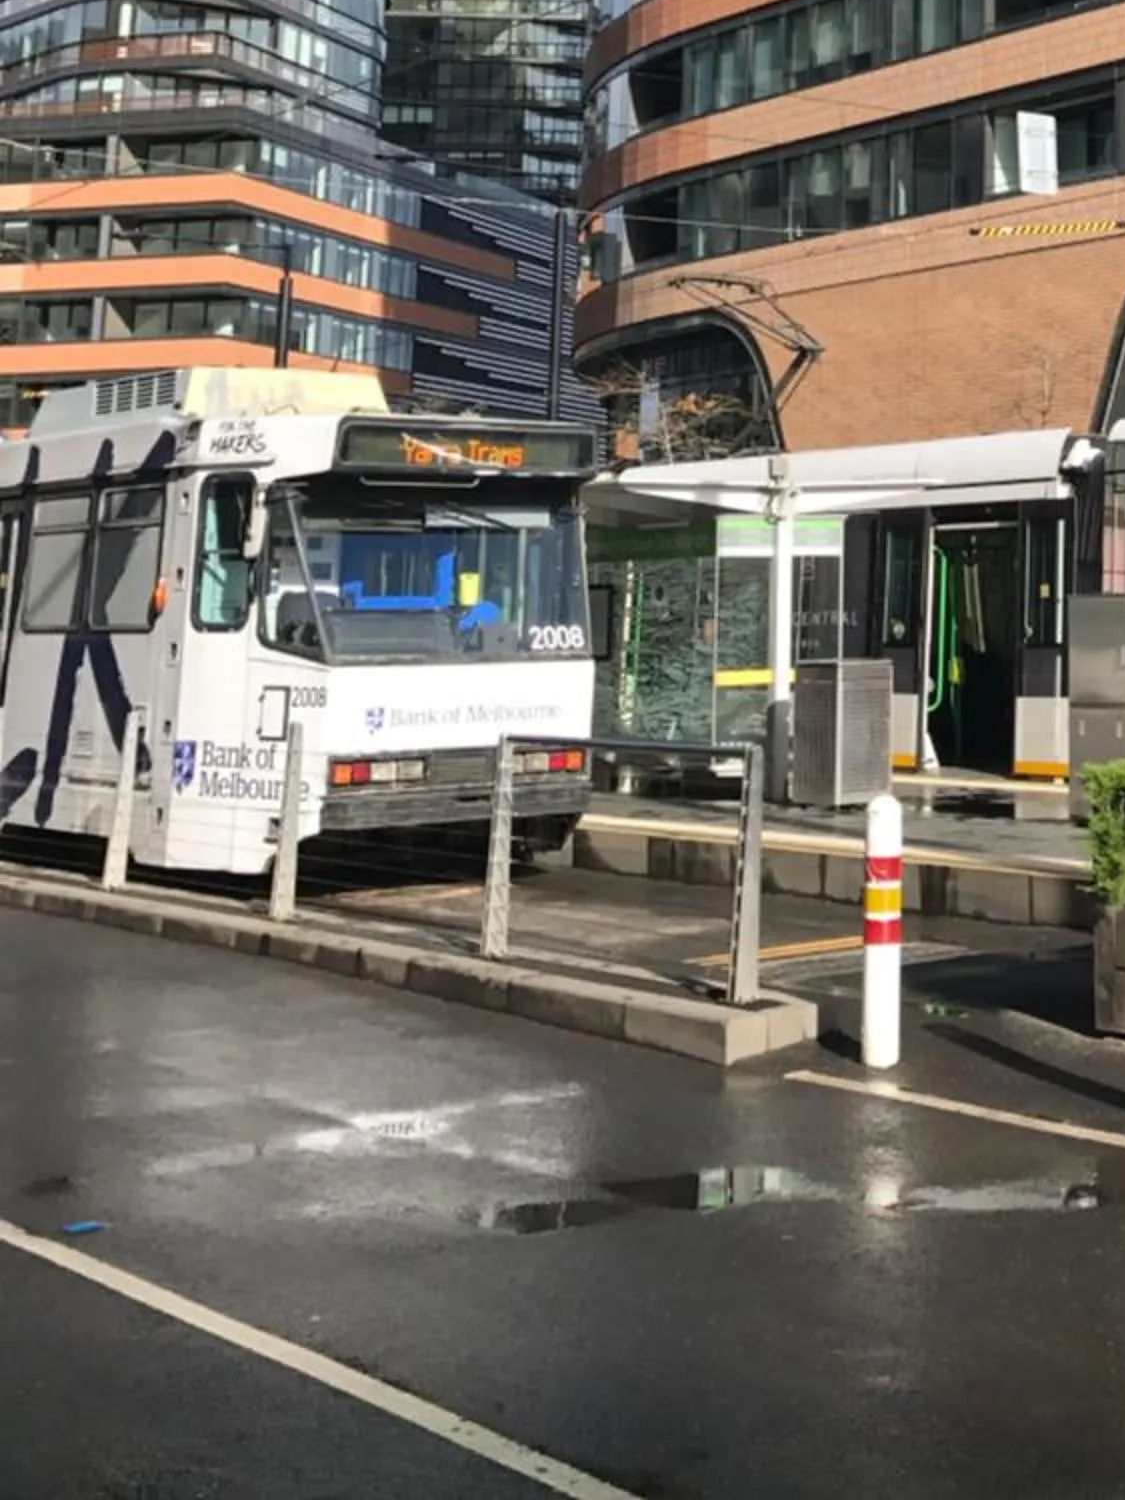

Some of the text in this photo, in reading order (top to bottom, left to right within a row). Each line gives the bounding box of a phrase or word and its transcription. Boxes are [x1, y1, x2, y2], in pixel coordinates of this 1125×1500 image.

[209, 432, 268, 453] MAKERS
[528, 625, 585, 650] 2008
[291, 686, 327, 709] 2008
[390, 702, 562, 728] Bank of Melbourne
[201, 740, 277, 770] Bank of
[199, 771, 311, 802] Melboure
